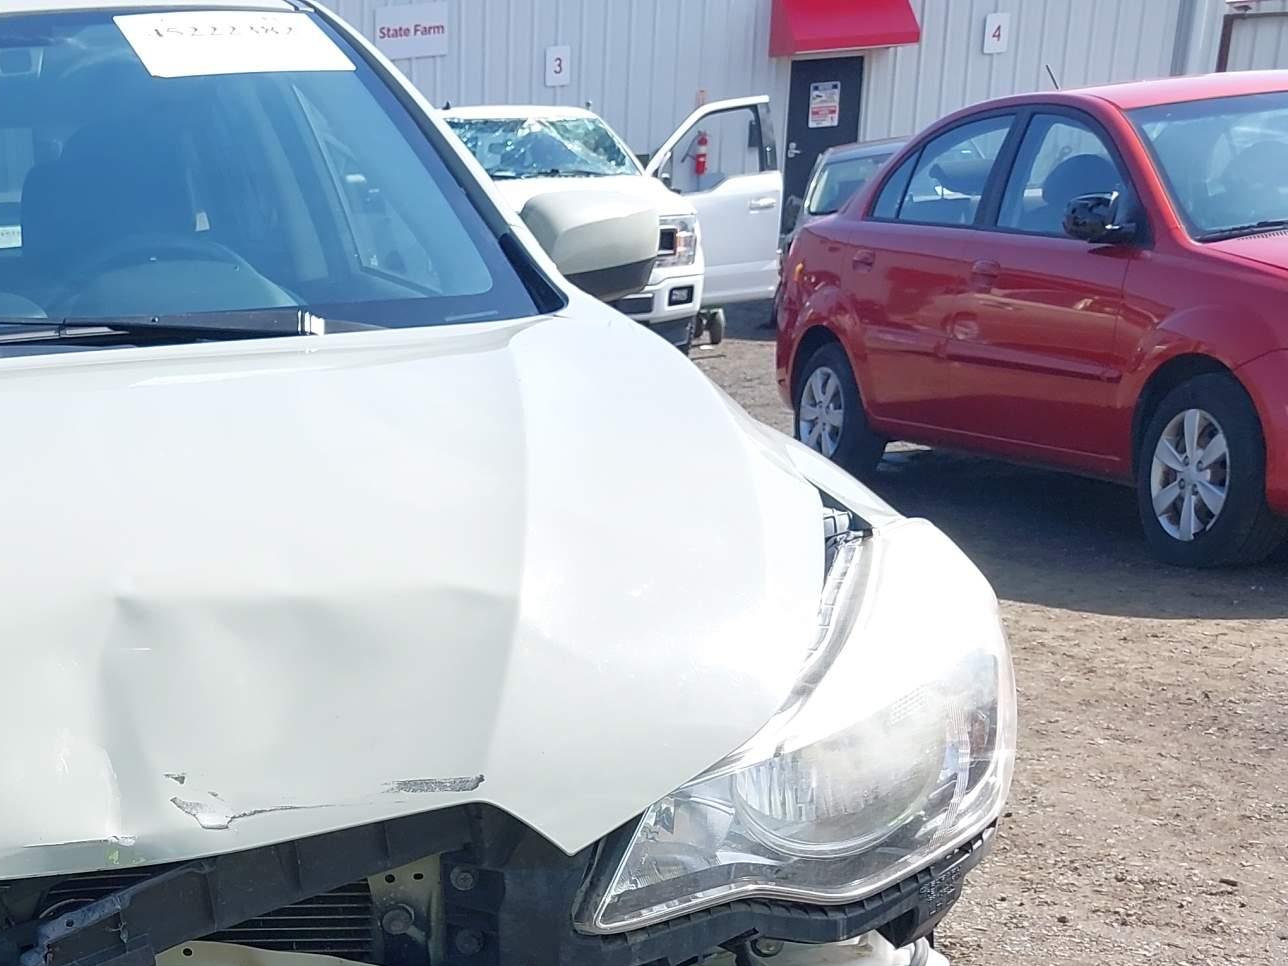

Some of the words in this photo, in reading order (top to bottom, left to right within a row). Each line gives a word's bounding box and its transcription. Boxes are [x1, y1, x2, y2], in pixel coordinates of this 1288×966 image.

[378, 26, 411, 40] State
[413, 23, 446, 37] Farm
[991, 24, 1002, 42] 4
[553, 57, 563, 75] 3
